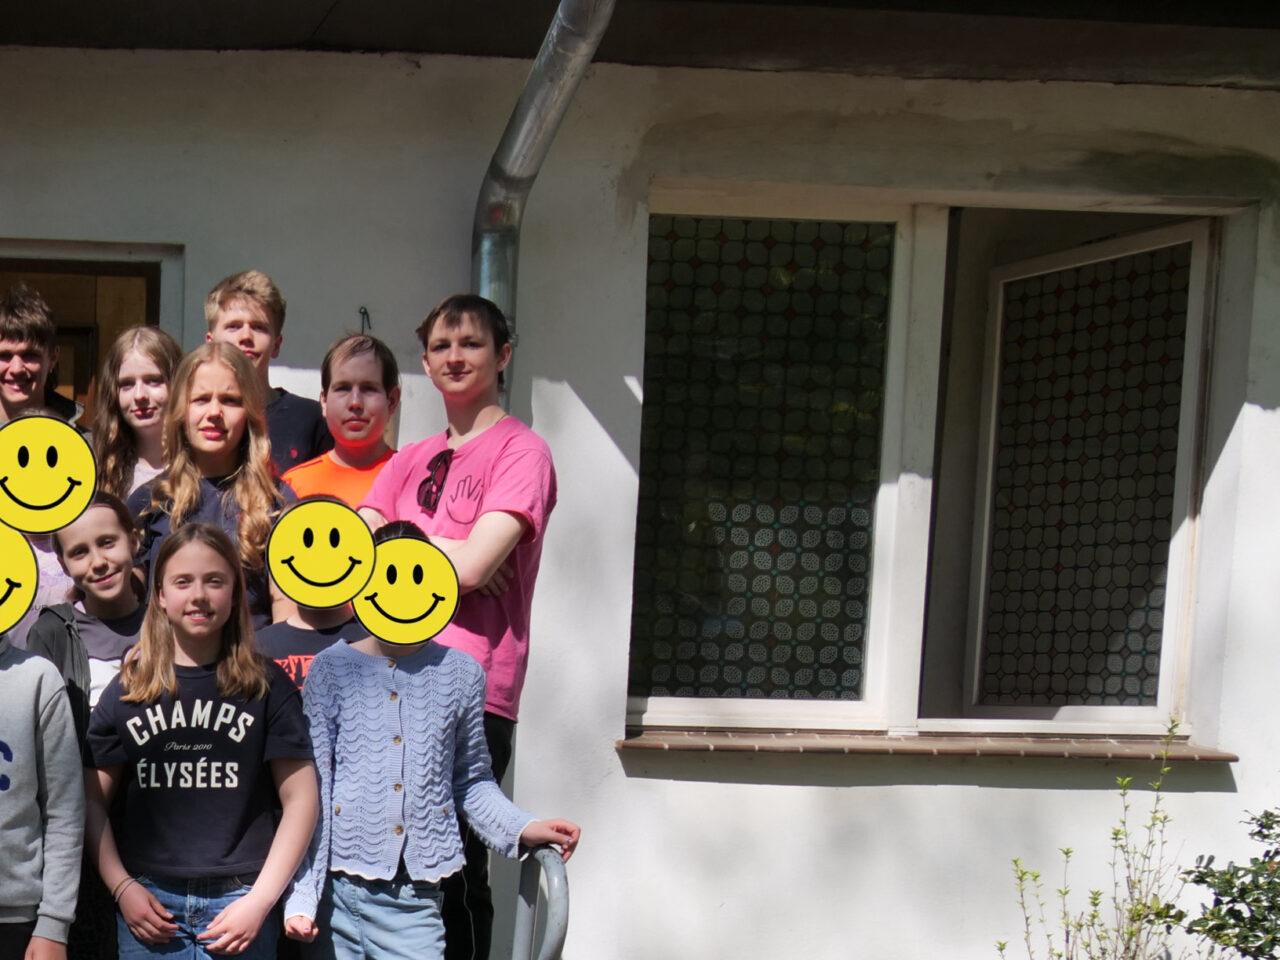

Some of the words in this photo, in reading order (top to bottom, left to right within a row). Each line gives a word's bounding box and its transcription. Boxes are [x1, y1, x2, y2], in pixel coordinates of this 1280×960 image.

[125, 698, 255, 747] CHAMPS
[164, 741, 192, 752] Paris
[136, 756, 240, 789] ÉLYSÉES
